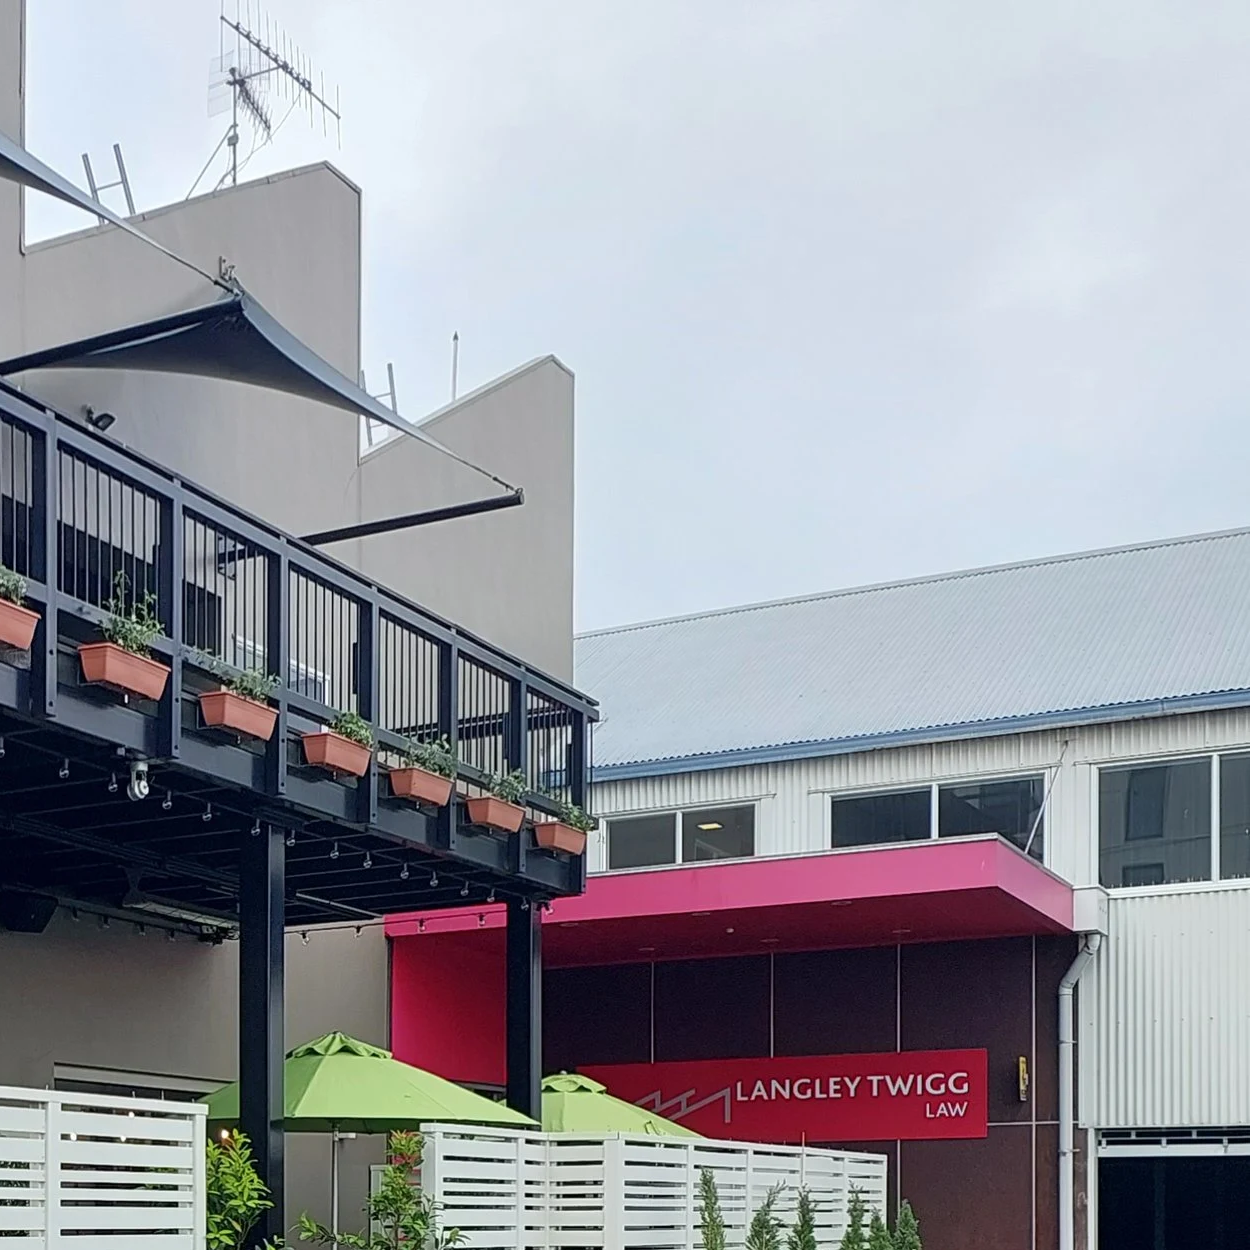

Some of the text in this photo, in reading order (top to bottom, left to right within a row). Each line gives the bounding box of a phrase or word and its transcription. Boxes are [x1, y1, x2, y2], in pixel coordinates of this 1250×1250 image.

[736, 1072, 969, 1101] LANGLEY TWIGG
[925, 1102, 968, 1118] LAW
